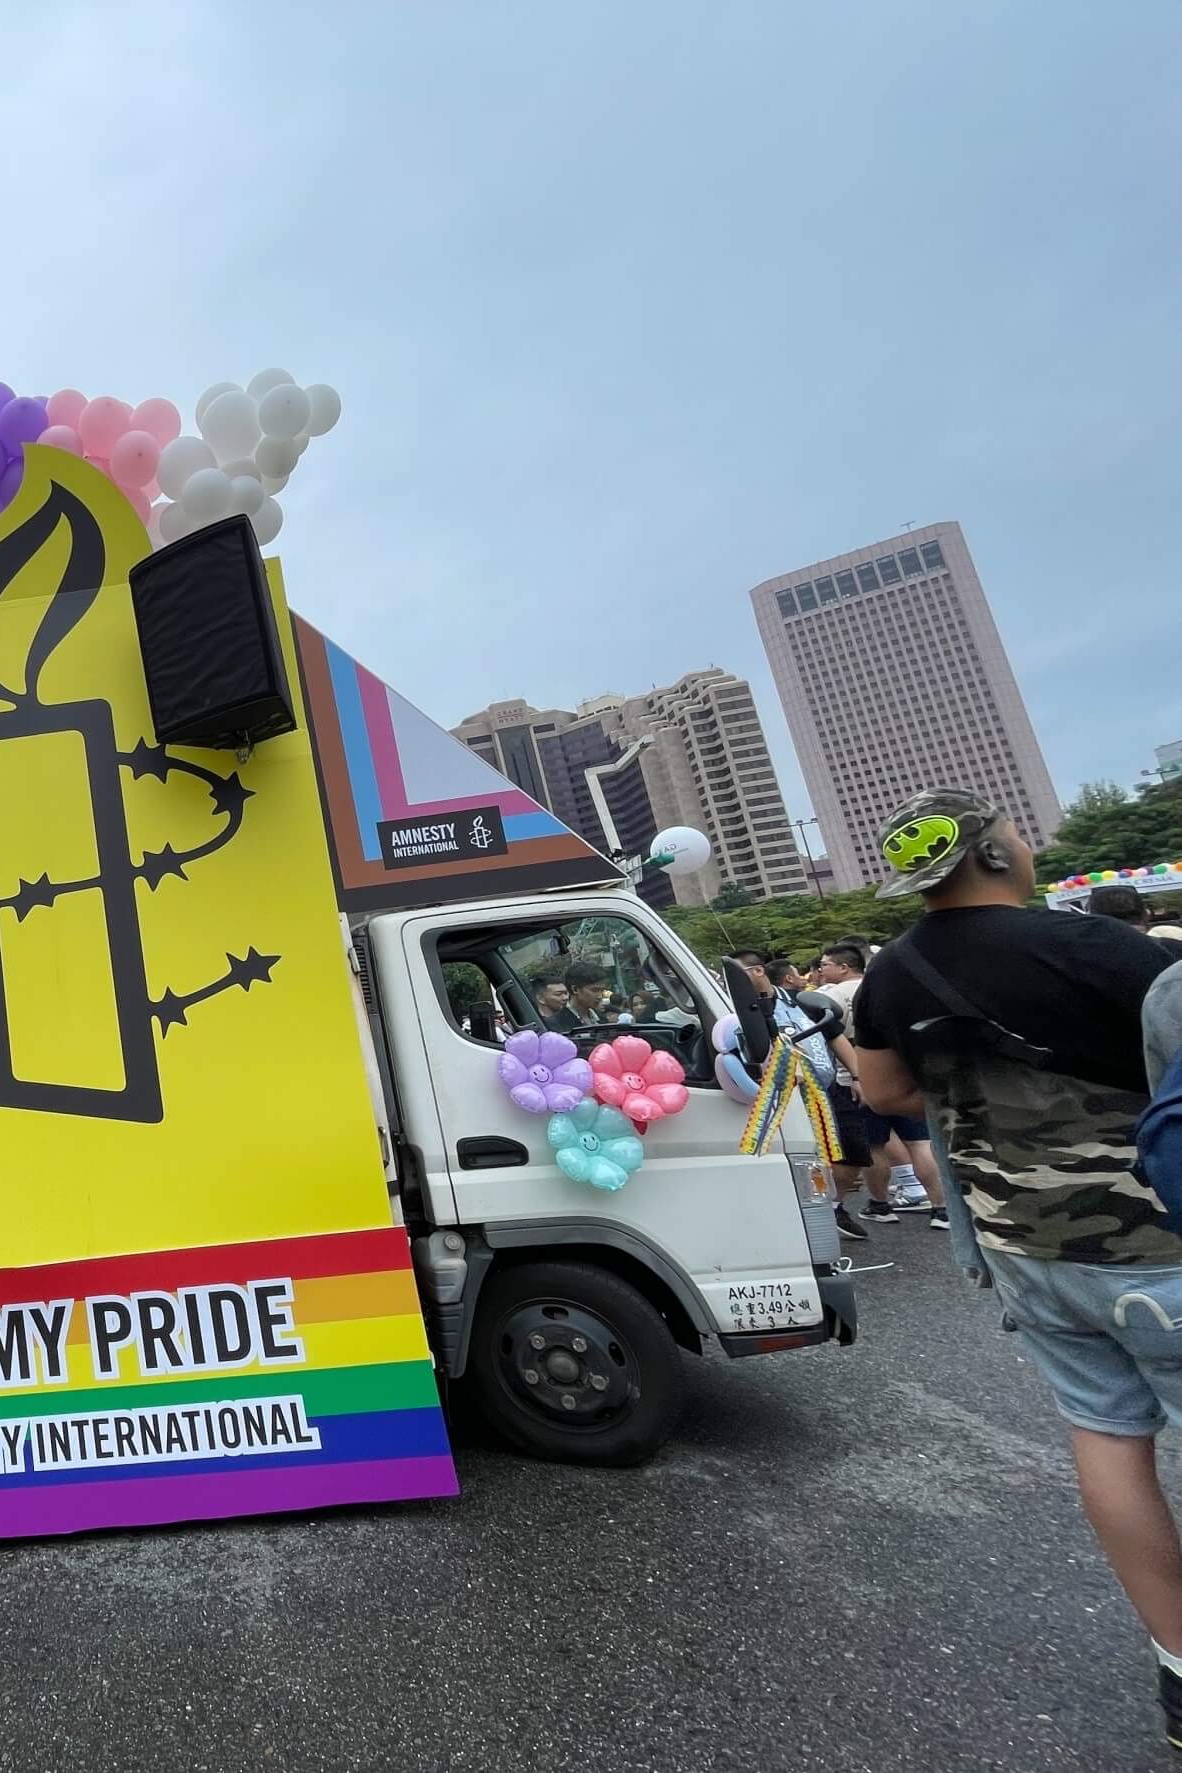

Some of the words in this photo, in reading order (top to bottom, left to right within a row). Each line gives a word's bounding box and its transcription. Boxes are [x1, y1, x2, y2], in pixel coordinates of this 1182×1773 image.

[391, 822, 456, 847] AMNESTY
[393, 840, 459, 858] INTERNATIONAL
[728, 1283, 793, 1301] AKJ-7712
[92, 1286, 298, 1373] PRIDE
[36, 1403, 313, 1463] INTERNATIONAL
